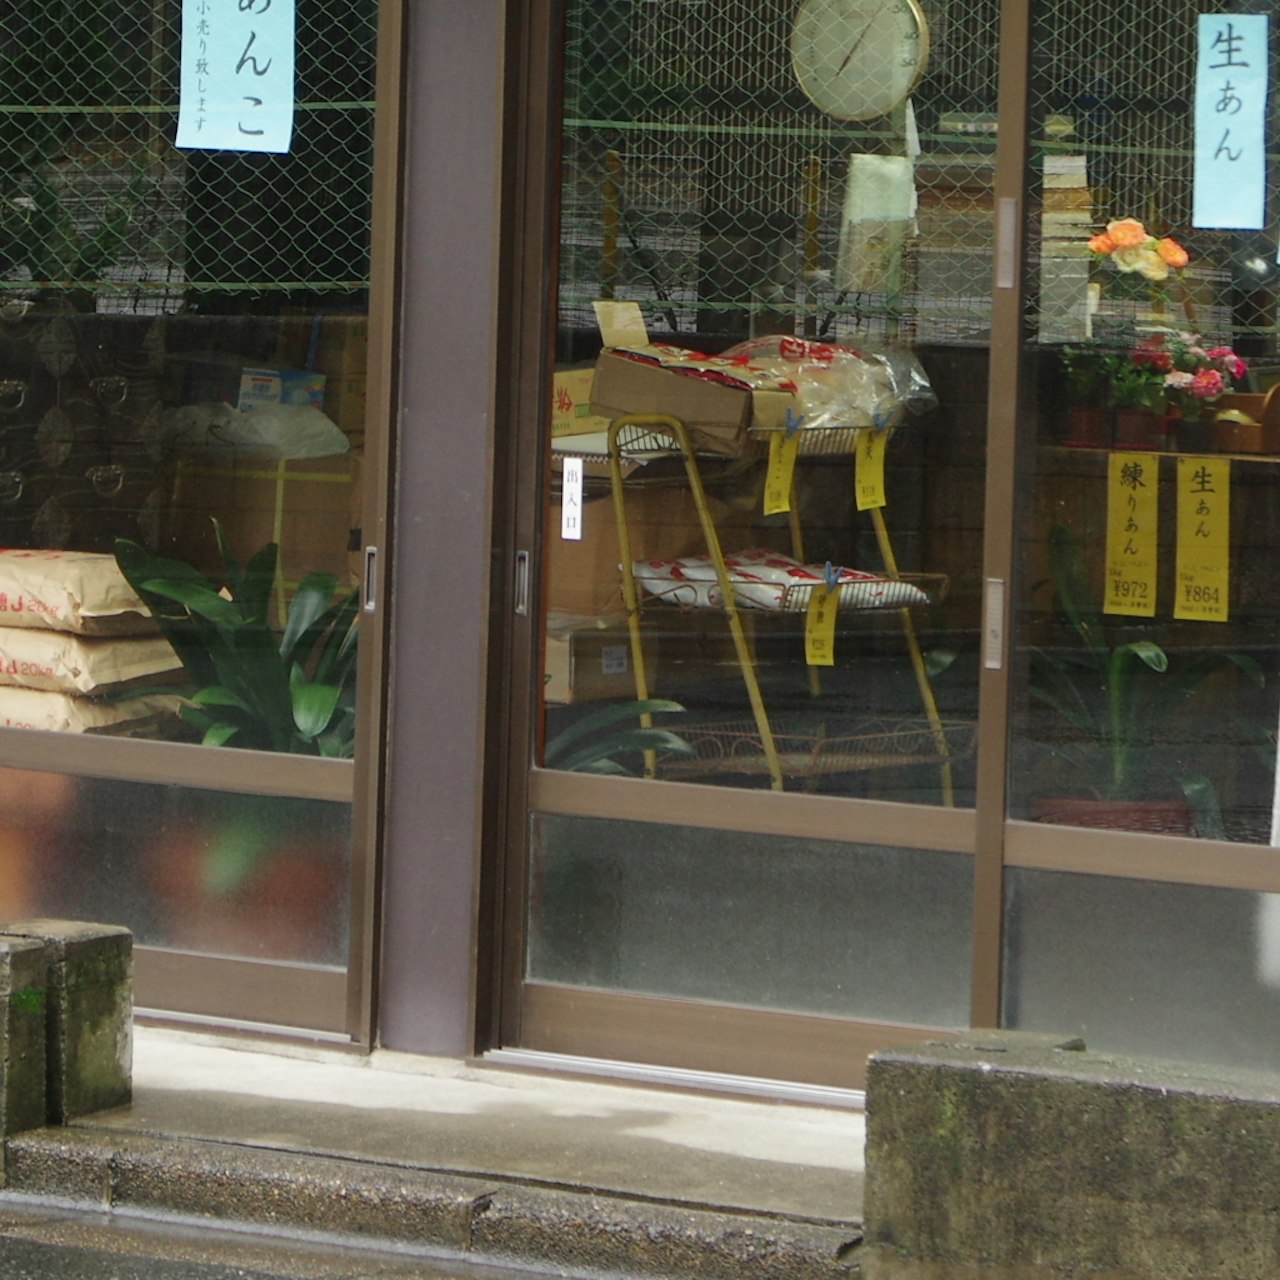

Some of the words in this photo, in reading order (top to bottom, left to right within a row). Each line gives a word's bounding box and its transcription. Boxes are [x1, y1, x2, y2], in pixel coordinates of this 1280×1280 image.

[194, 0, 211, 132] 小売り致します
[1208, 23, 1251, 162] 生あん
[566, 469, 579, 529] 出入口
[1120, 462, 1147, 556] 練りあん
[1189, 466, 1216, 538] 生あん
[1113, 579, 1148, 599] ¥972
[1184, 585, 1220, 604] ¥864
